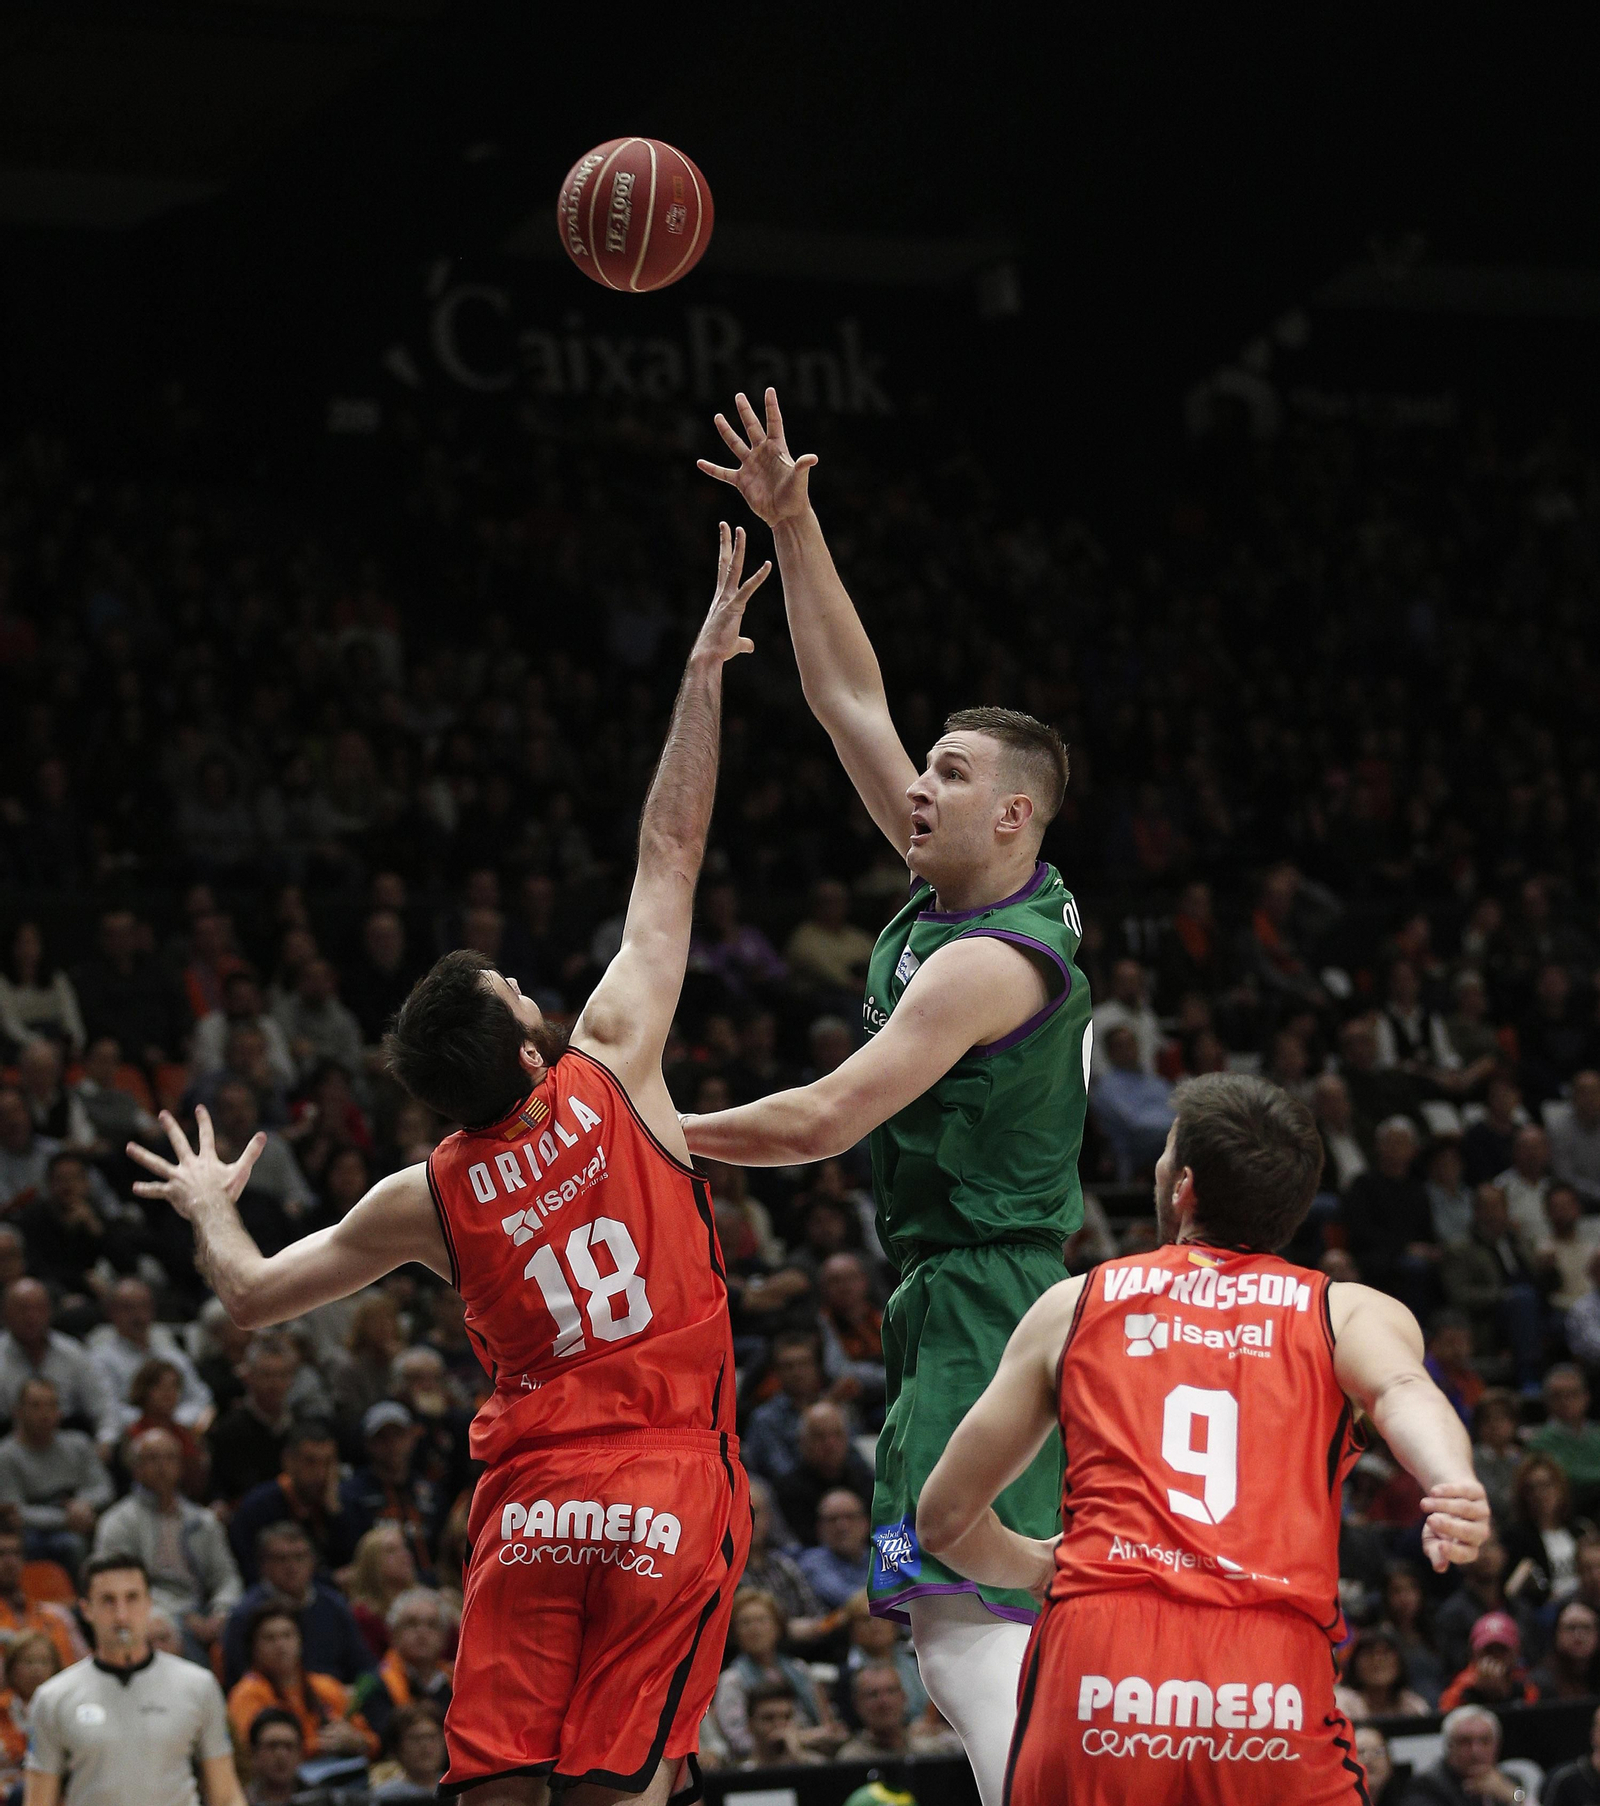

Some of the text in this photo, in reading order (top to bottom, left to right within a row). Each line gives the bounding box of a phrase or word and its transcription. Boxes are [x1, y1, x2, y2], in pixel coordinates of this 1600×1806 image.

[567, 154, 604, 256] SPALDING
[607, 172, 634, 254] TF-1000
[468, 1095, 602, 1204] ORIOLA
[535, 1145, 607, 1217] isaval
[524, 1216, 653, 1357] 18
[1104, 1267, 1172, 1302] VAN
[1173, 1316, 1273, 1349] isaval
[1162, 1384, 1238, 1525] 9
[501, 1500, 681, 1555] PAMESA
[499, 1543, 662, 1579] ceramica
[1078, 1675, 1303, 1731] PAMESA
[1082, 1729, 1300, 1762] ceramica
